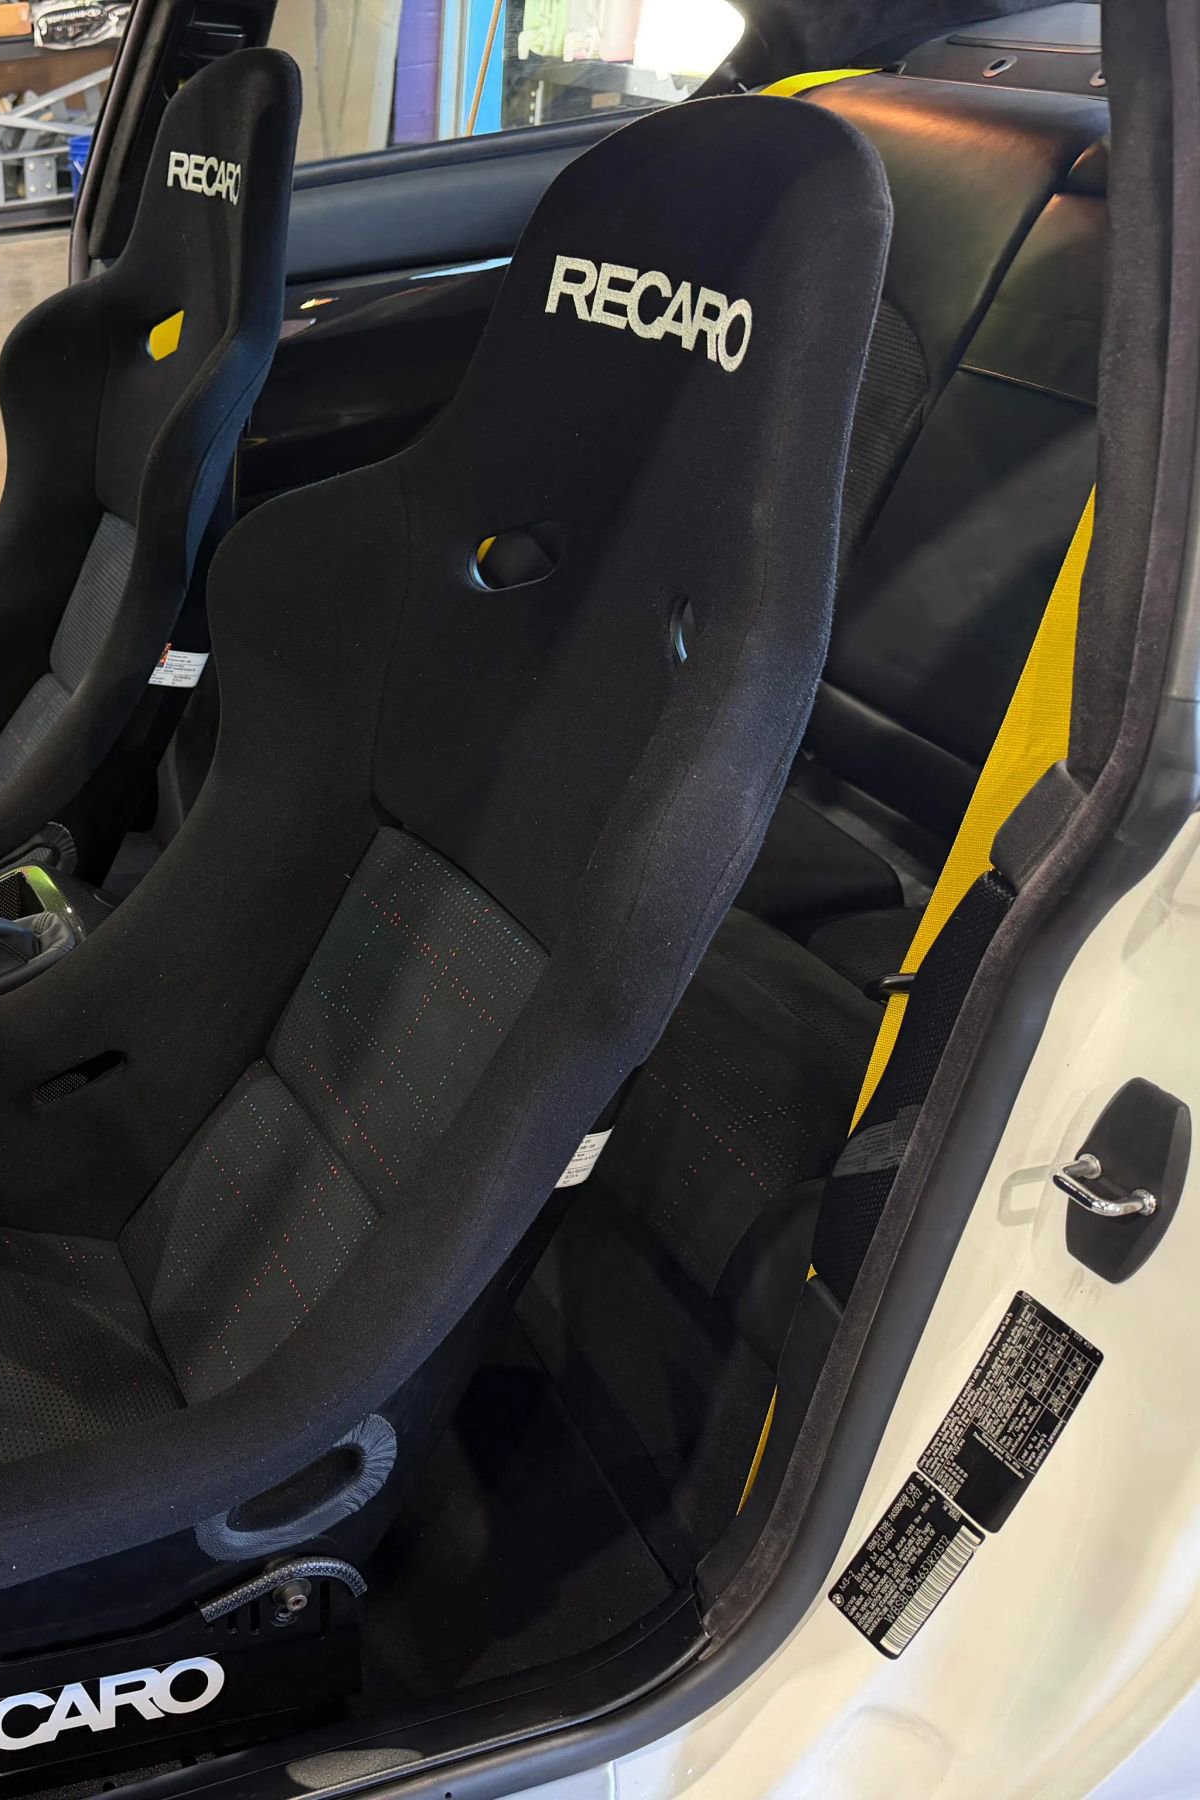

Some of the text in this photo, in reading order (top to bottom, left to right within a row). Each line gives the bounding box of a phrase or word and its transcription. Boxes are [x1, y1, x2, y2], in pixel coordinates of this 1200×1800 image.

[167, 151, 241, 205] RECARO
[545, 255, 752, 372] RECARO
[906, 1488, 922, 1508] 12/02
[855, 1562, 870, 1582] BMW
[870, 1552, 878, 1562] M
